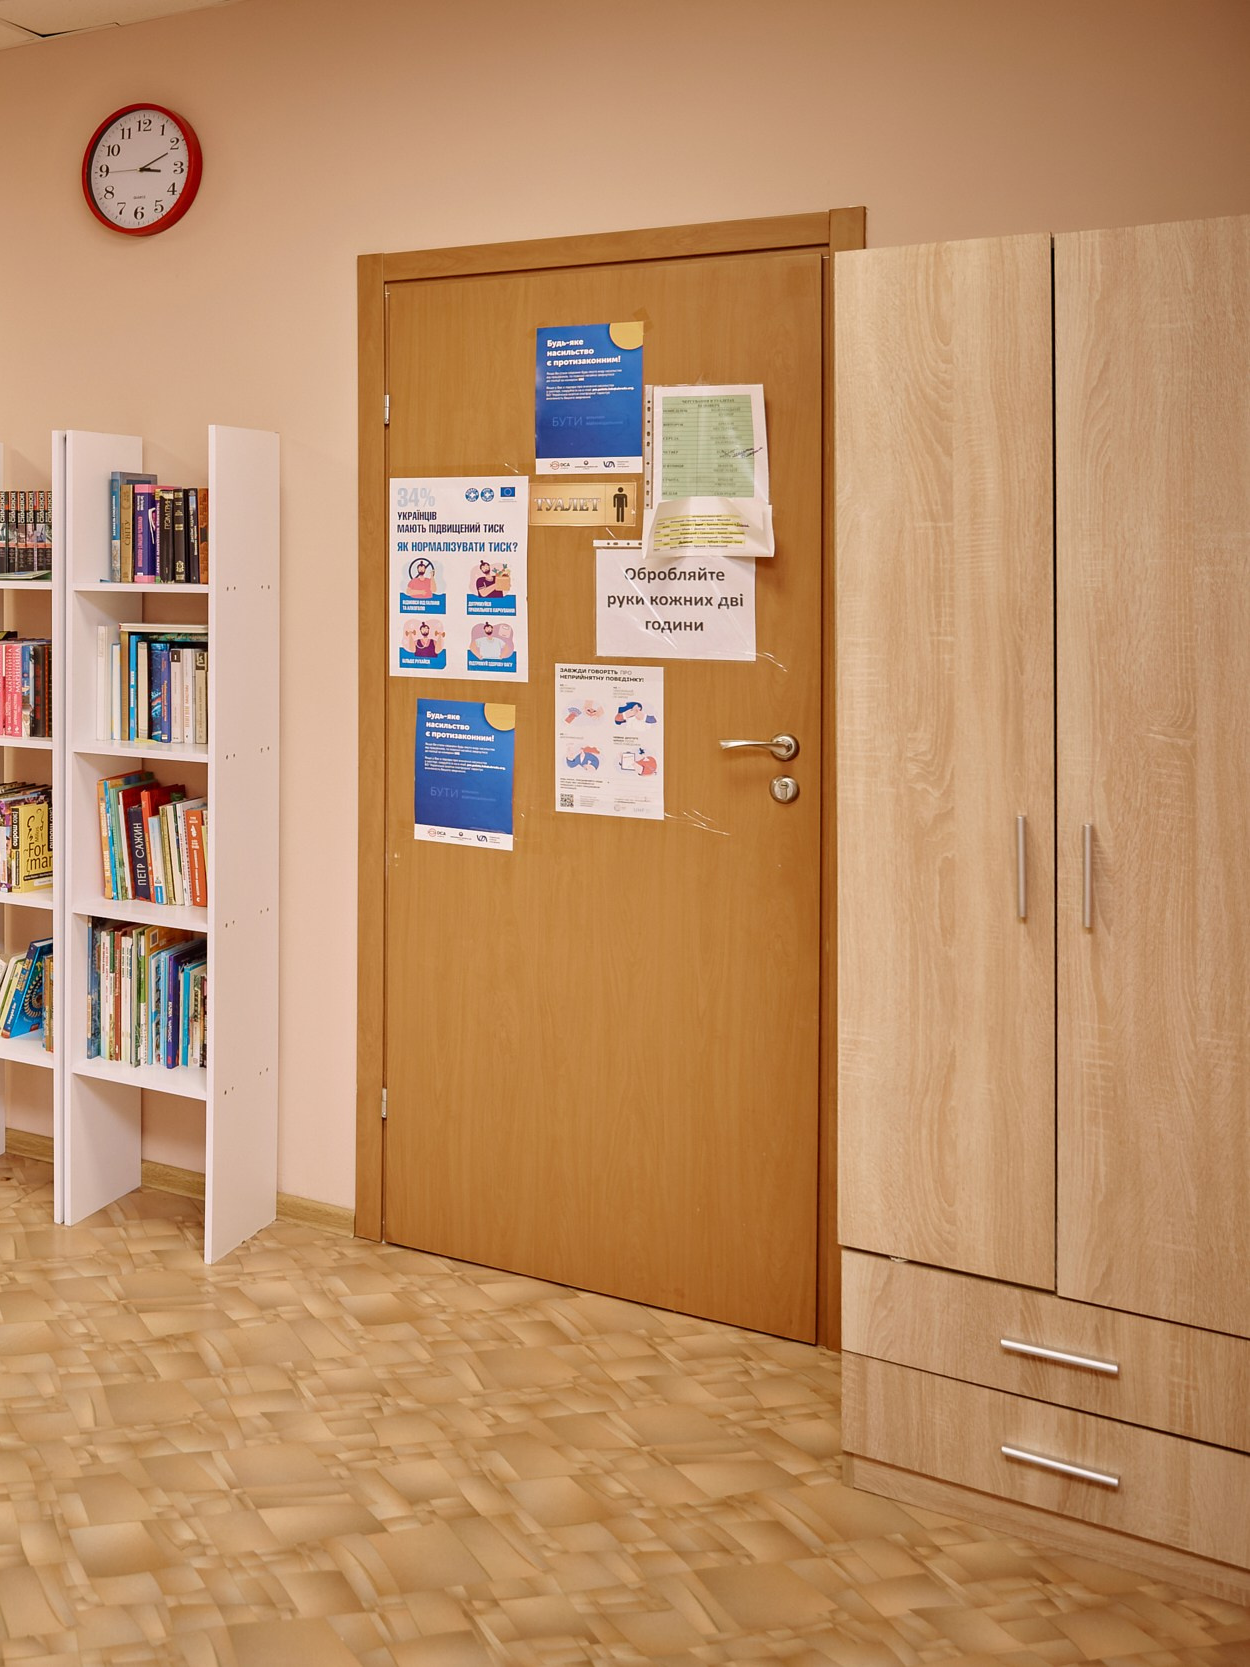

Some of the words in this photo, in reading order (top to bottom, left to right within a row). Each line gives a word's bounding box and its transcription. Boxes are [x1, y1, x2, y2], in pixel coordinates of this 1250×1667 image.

[137, 119, 152, 132] 12
[160, 124, 165, 136] 1
[121, 128, 130, 139] 11
[107, 144, 120, 156] 10
[170, 138, 179, 150] 2
[99, 164, 109, 178] 9
[174, 161, 184, 174] 3
[104, 186, 114, 199] 8
[167, 182, 177, 195] 4
[117, 202, 126, 215] 7
[134, 206, 144, 220] 6
[154, 200, 163, 213] 5
[547, 339, 583, 348] Будь-яке
[547, 349, 594, 357] насильство
[554, 356, 621, 367] протизаконним!
[553, 417, 582, 427] БУТИ
[398, 488, 435, 507] 34%
[534, 498, 601, 511] ТУАЛЕТ
[398, 510, 437, 521] УКРАЇНЦІВ
[397, 524, 426, 533] МАЮТЬ
[429, 522, 480, 534] ПІДВИЩЕНИЙ
[483, 524, 504, 533] ТИСК
[398, 542, 408, 551] ЯК
[412, 542, 485, 552] НОРМАЛІЗУВАТИ
[488, 542, 518, 552] ТИСК?
[624, 568, 725, 583] Обробляйте
[607, 595, 644, 608] руки
[650, 595, 713, 606] кожних
[718, 594, 743, 609] дві
[646, 620, 704, 633] години
[427, 711, 460, 721] Будь-яке
[426, 722, 470, 730] насильство
[432, 732, 494, 742] протизаконним!
[133, 822, 144, 858] САЖИН
[29, 842, 46, 857] For
[137, 863, 146, 886] ПЕТР
